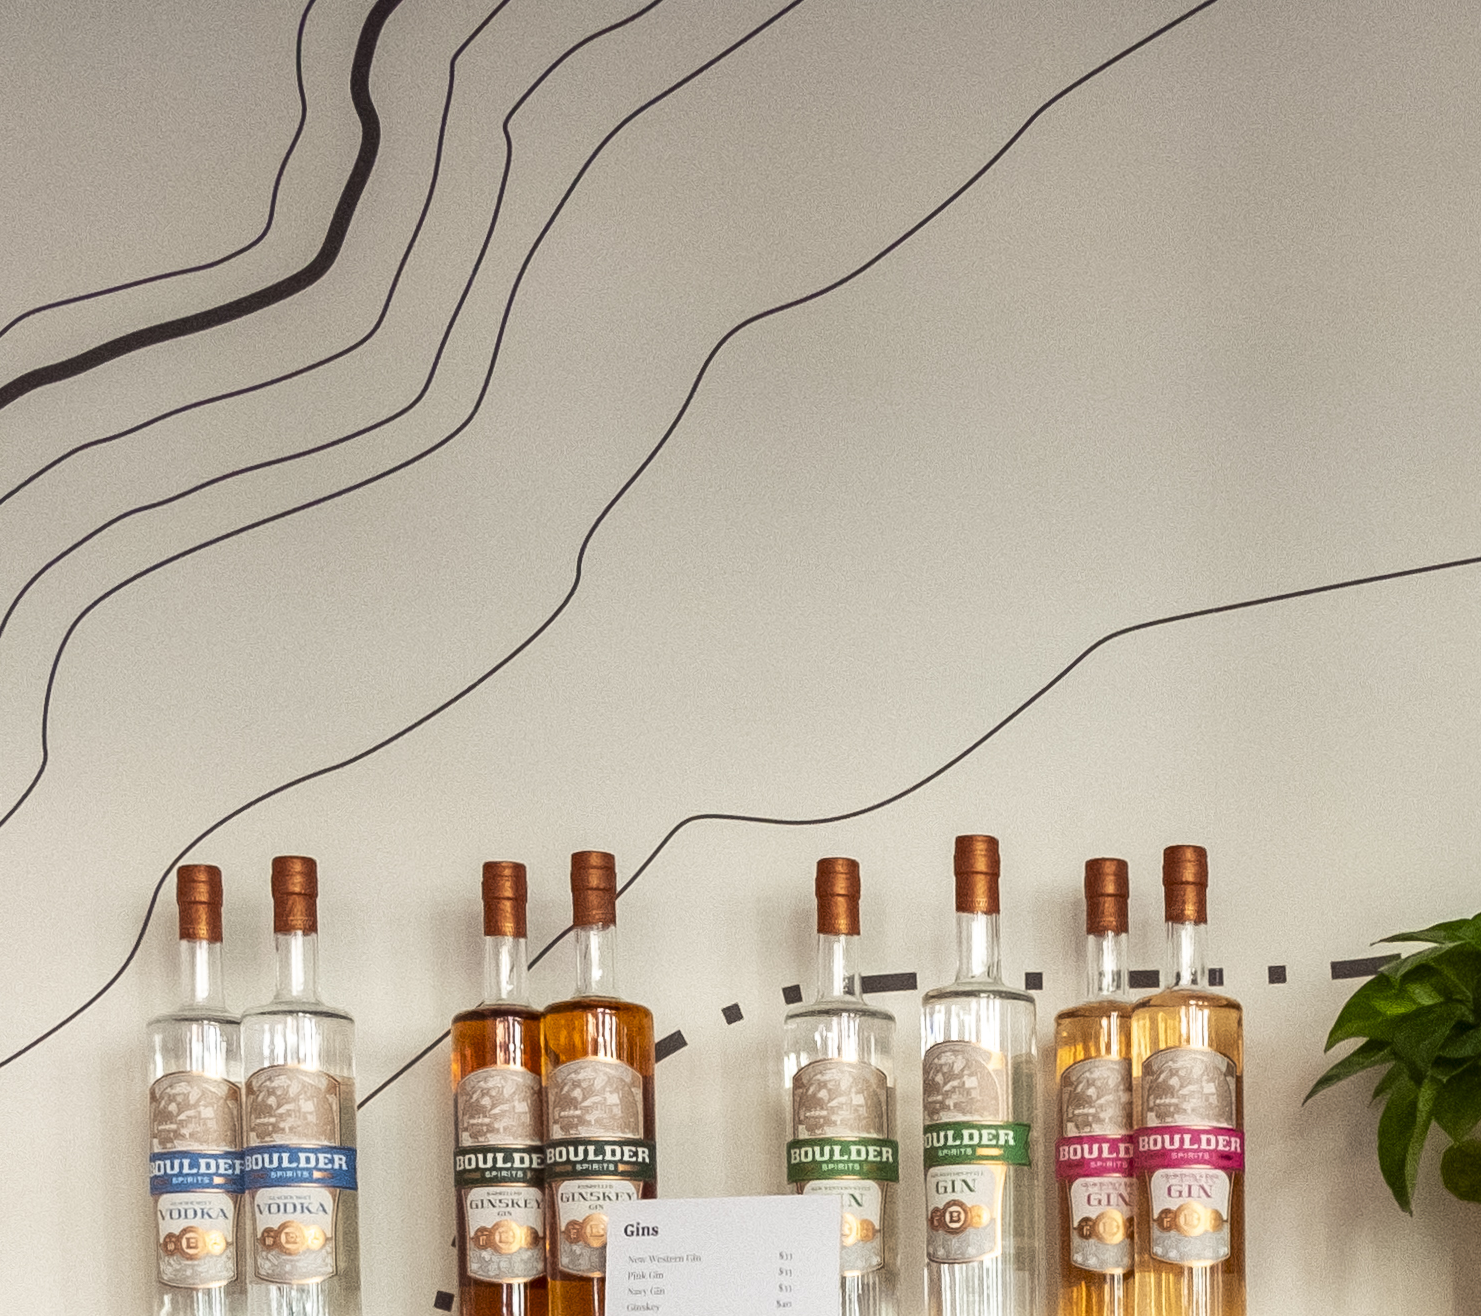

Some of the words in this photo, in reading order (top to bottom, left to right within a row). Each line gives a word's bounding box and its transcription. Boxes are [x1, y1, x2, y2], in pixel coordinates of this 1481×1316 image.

[1139, 1134, 1242, 1153] BOULDER
[546, 1145, 650, 1165] BOULDER
[790, 1145, 893, 1164] BOULDER
[935, 1180, 978, 1196] GIN
[1167, 1184, 1212, 1199] GIN
[560, 1191, 635, 1204] GINSKEY
[159, 1207, 230, 1222] VODKA
[257, 1201, 329, 1216] VODKA
[623, 1223, 659, 1238] Gins
